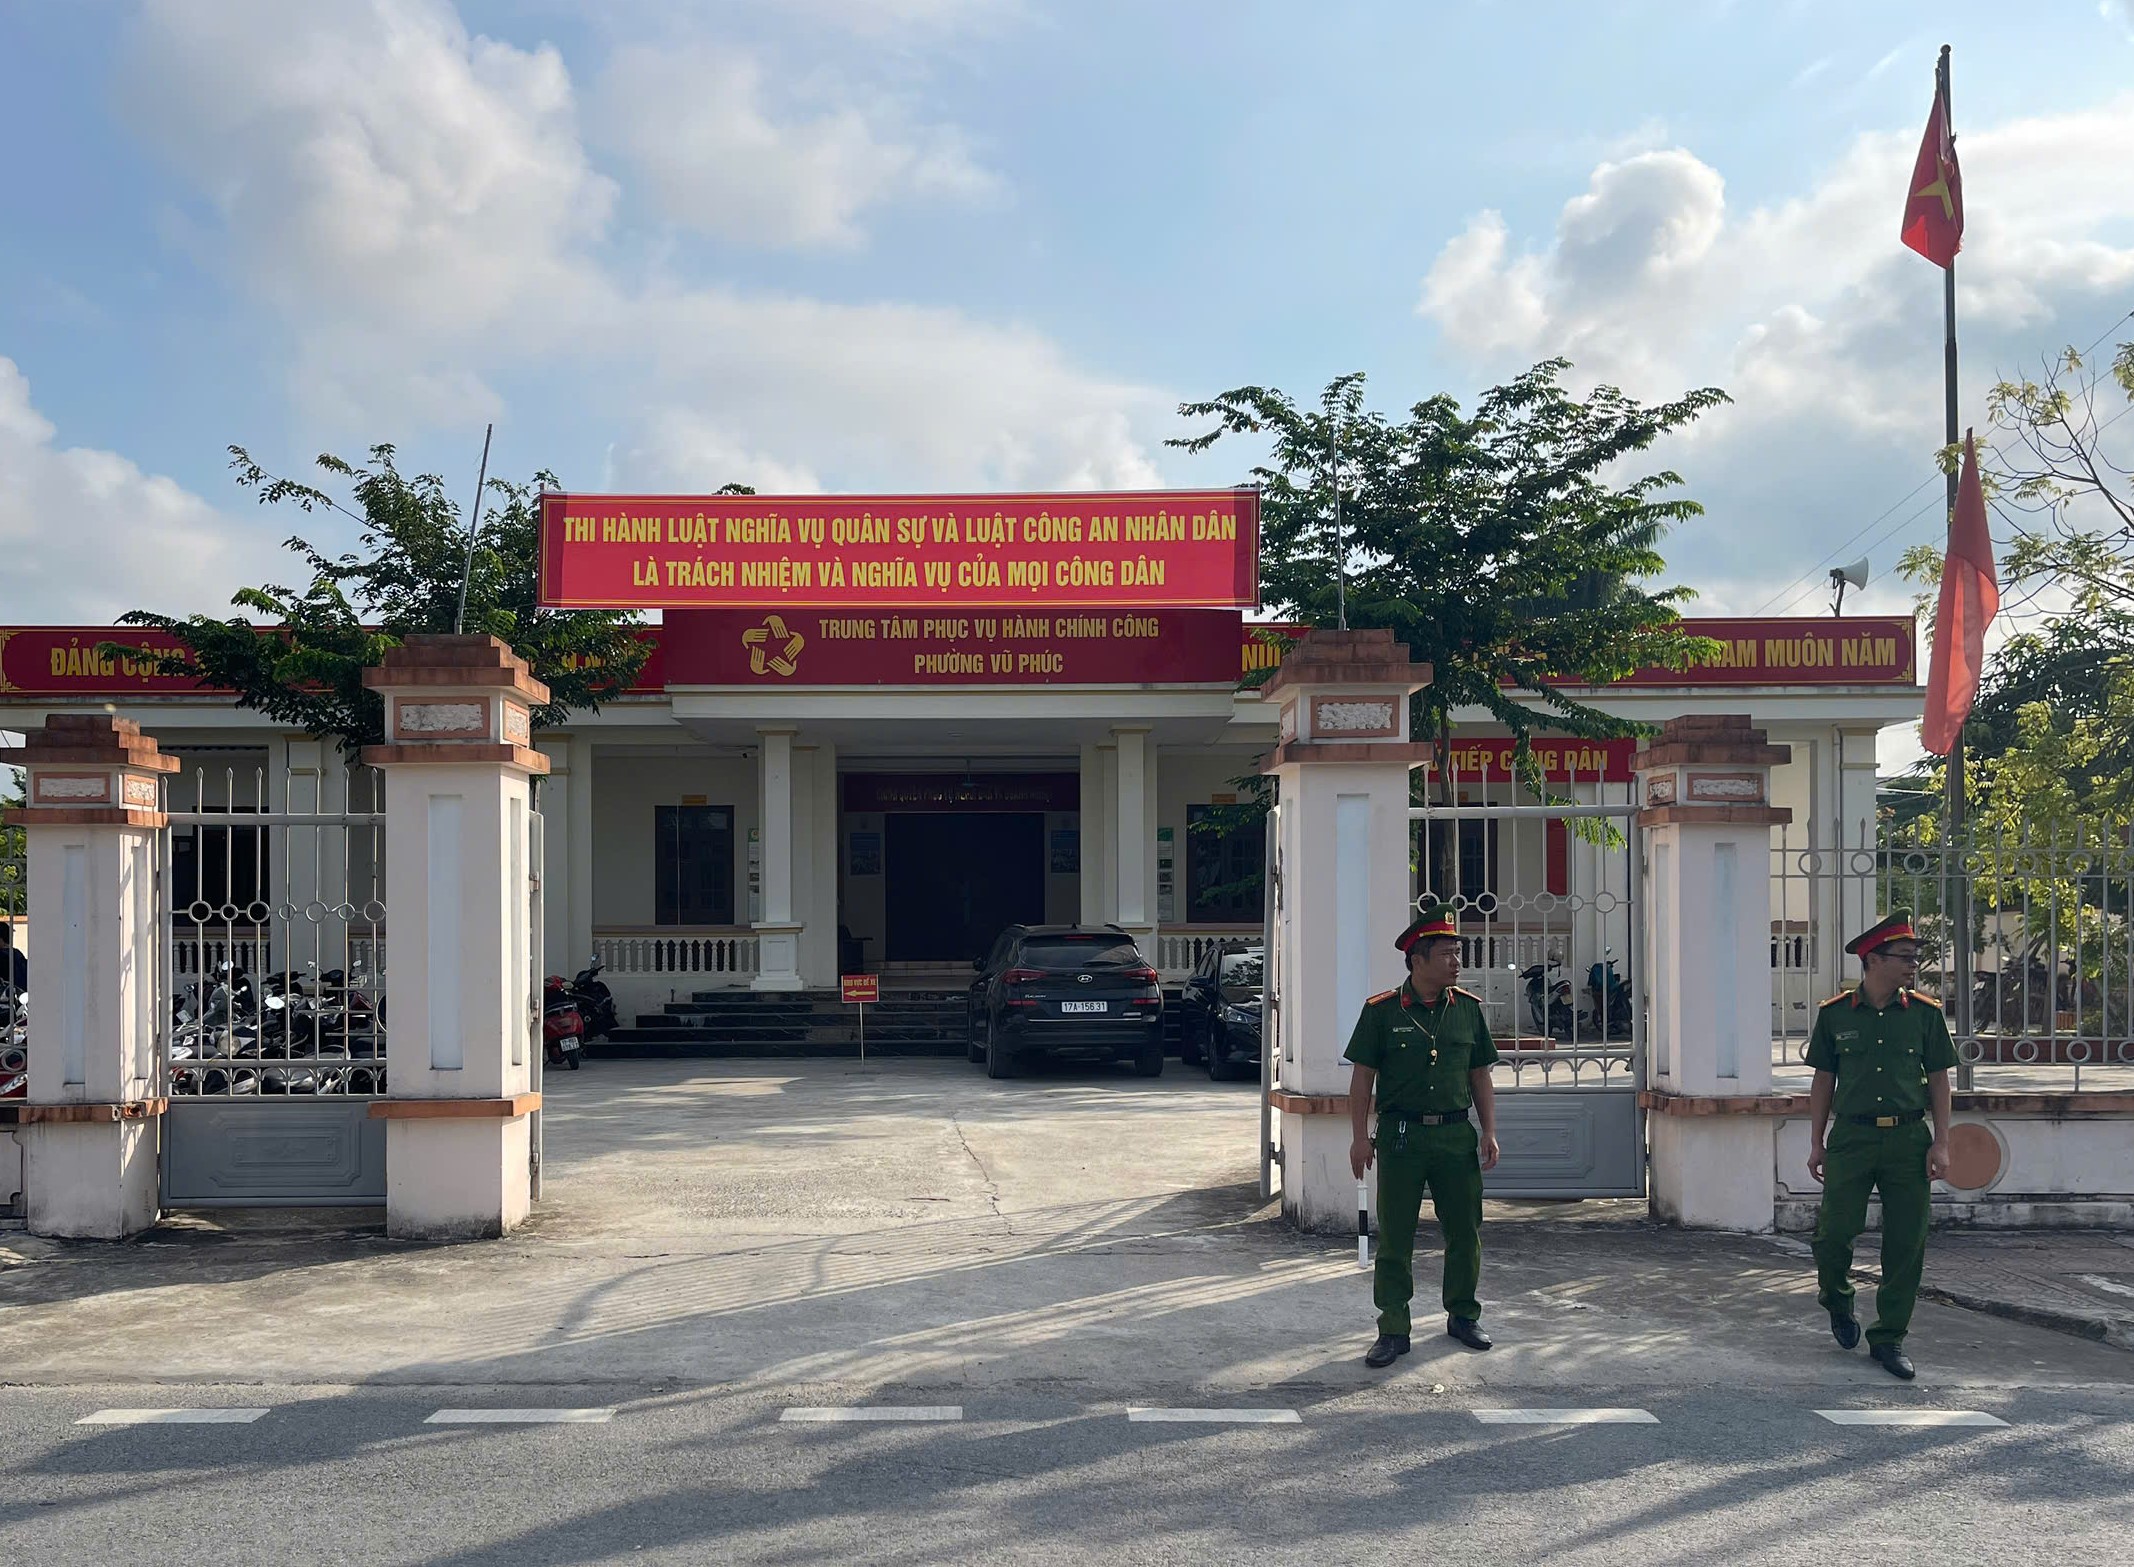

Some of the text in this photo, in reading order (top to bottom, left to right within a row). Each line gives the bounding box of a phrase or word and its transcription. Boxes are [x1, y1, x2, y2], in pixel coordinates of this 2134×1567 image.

[564, 510, 1237, 548] THI HÀNH LUẬT NGHĨA VỤ QUÂN SỰ VÀ LUẬT CÔNG AN NHÂN DÂN
[633, 553, 1165, 592] LÀ TRÁCH NHIỆM VÀ NGHĨA VỤ CỦA MỌI CÔNG DÂN
[819, 613, 1160, 643] TRUNG TÂM PHỤC VỤ HÀNH CHÍNH CÔNG
[50, 637, 115, 676] ĐẢNG
[914, 648, 1064, 674] PHƯỜNG VŨ PHÚC
[1764, 631, 1835, 668] MUÔN
[1840, 631, 1896, 667] NĂM
[1449, 744, 1493, 771] TIẾP
[1500, 750, 1557, 771] CNG
[1564, 746, 1608, 771] DÂN
